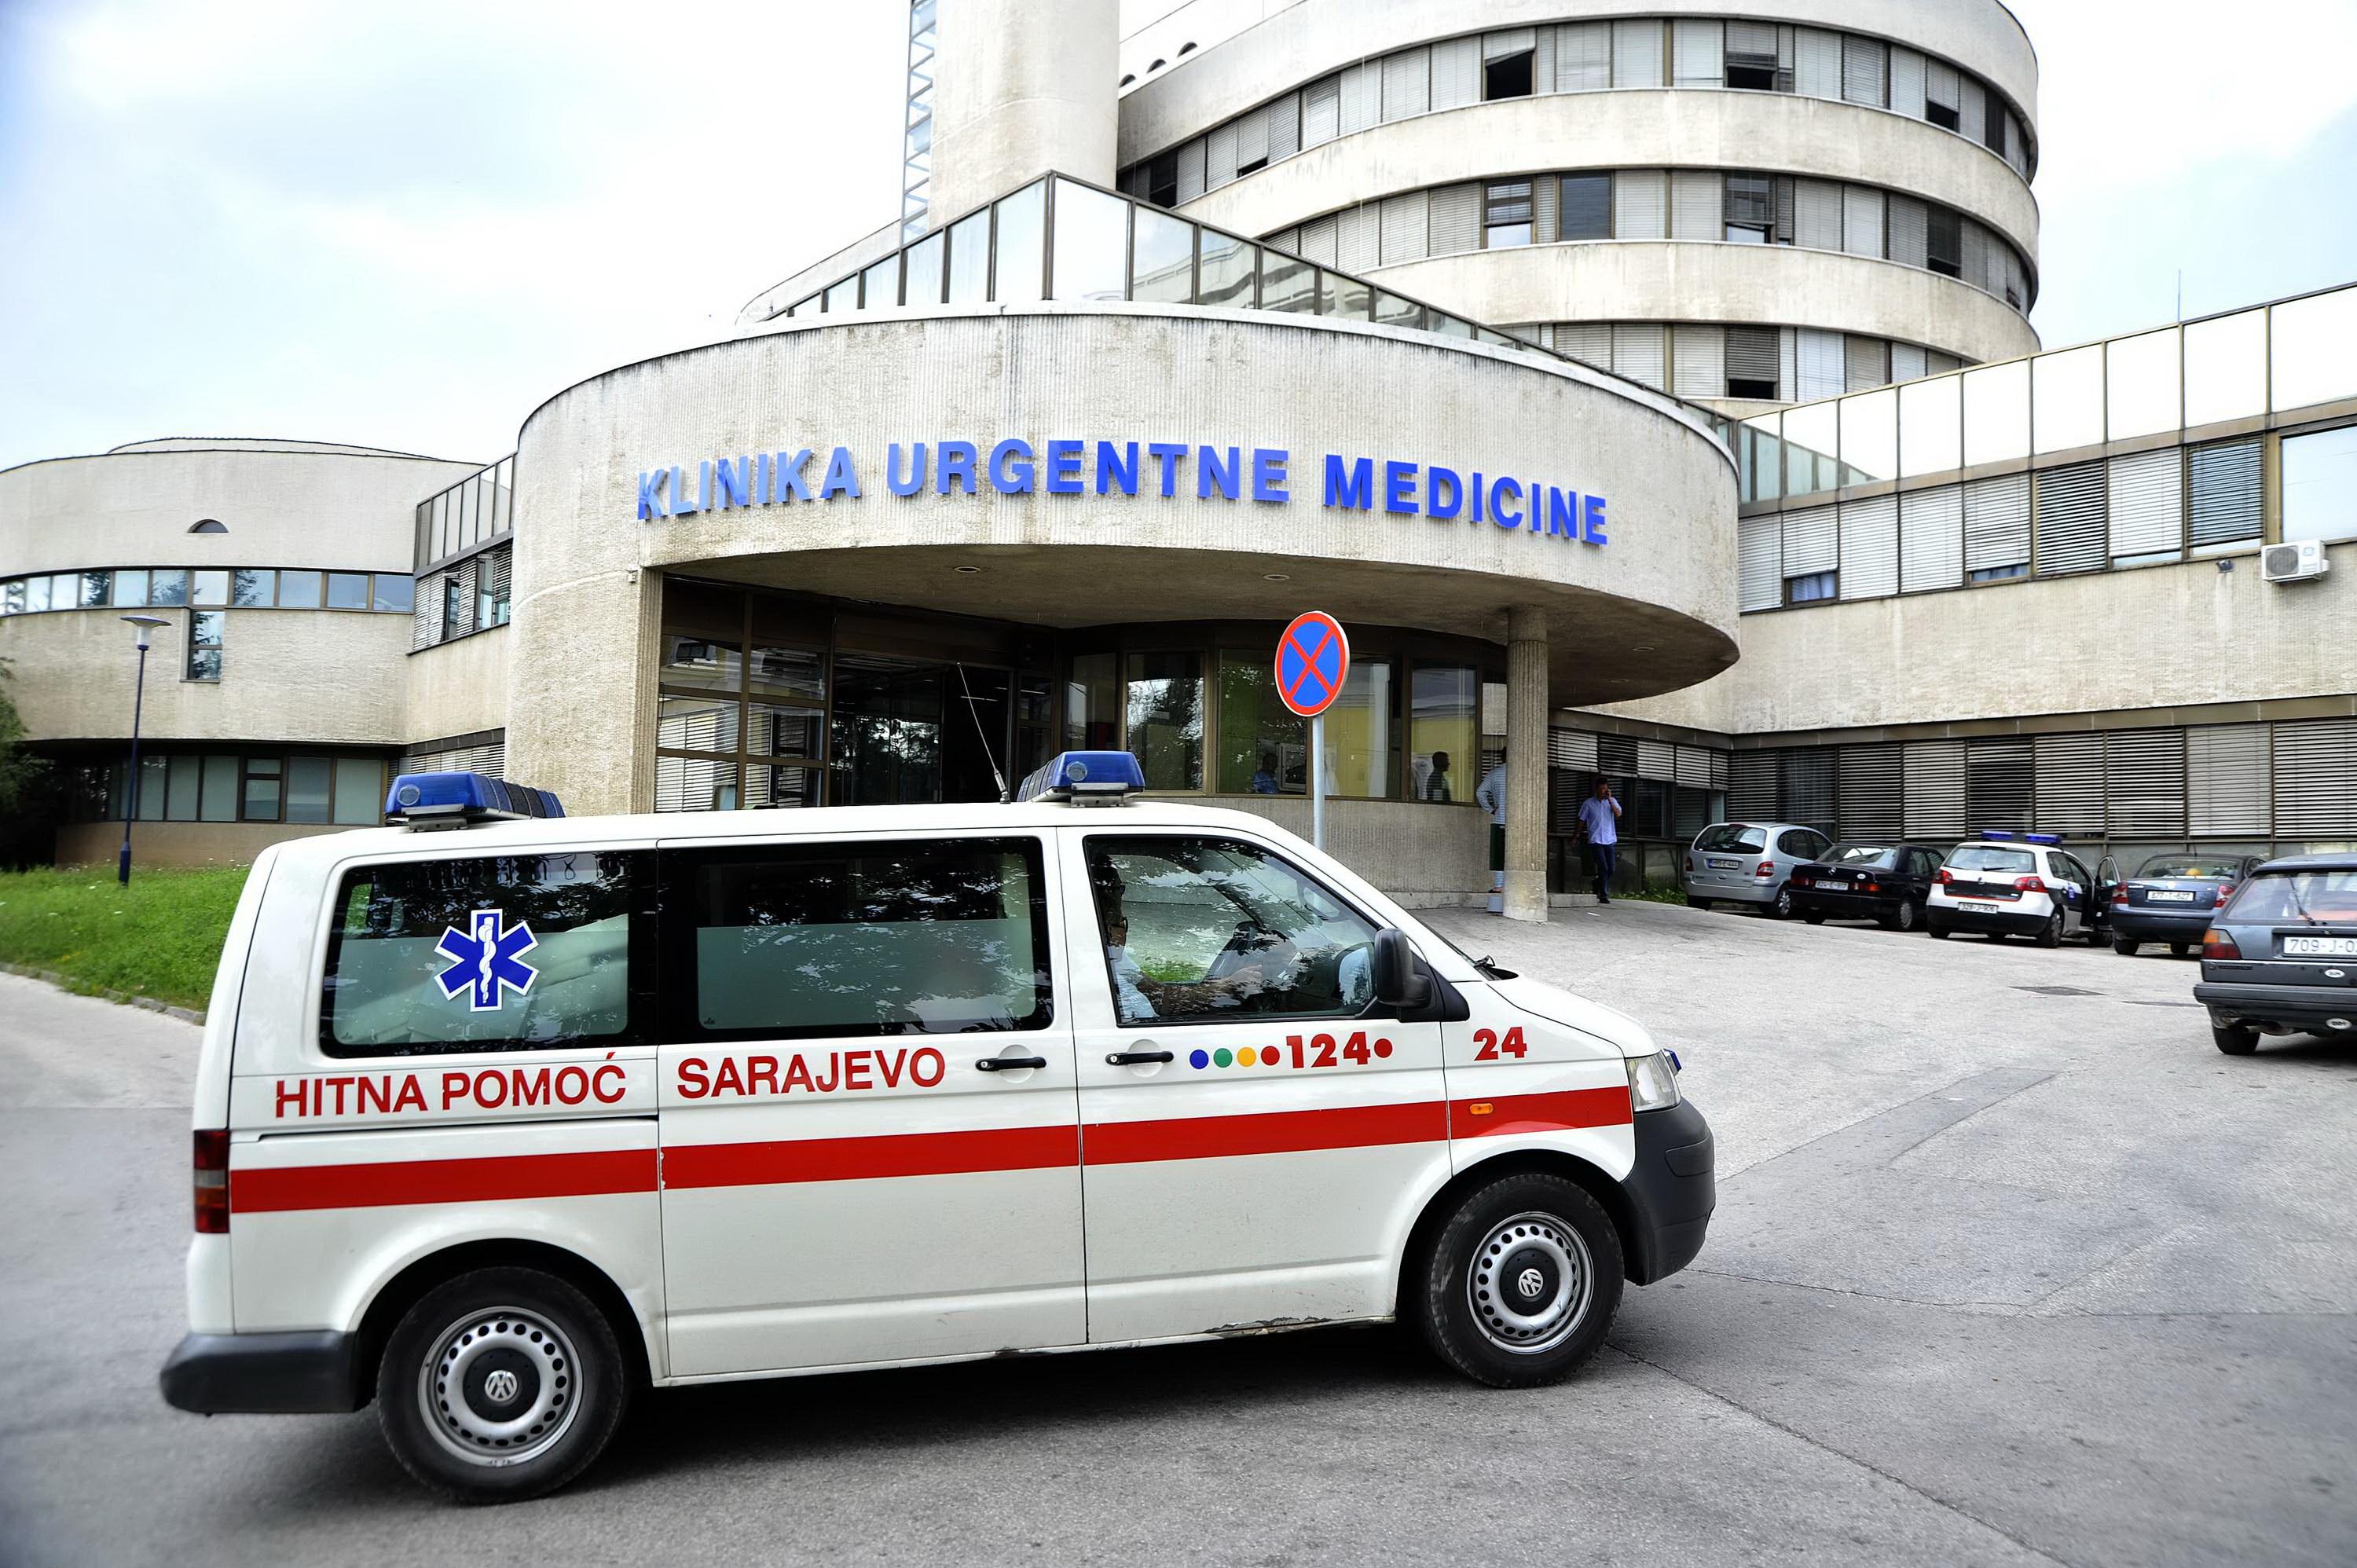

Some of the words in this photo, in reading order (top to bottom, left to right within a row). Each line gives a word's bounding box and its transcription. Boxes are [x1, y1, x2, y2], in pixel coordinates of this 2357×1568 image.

[637, 447, 860, 521] KLINIKA
[887, 438, 1291, 504] URGENTNE
[1324, 453, 1608, 546] MEDICINE
[2289, 938, 2357, 954] 709-J-0
[1286, 1031, 1371, 1069] 124
[1473, 1027, 1528, 1061] 24
[276, 1075, 427, 1118] HITNA
[442, 1051, 626, 1111] POMOĆ
[678, 1047, 946, 1099] SARAJEVO
